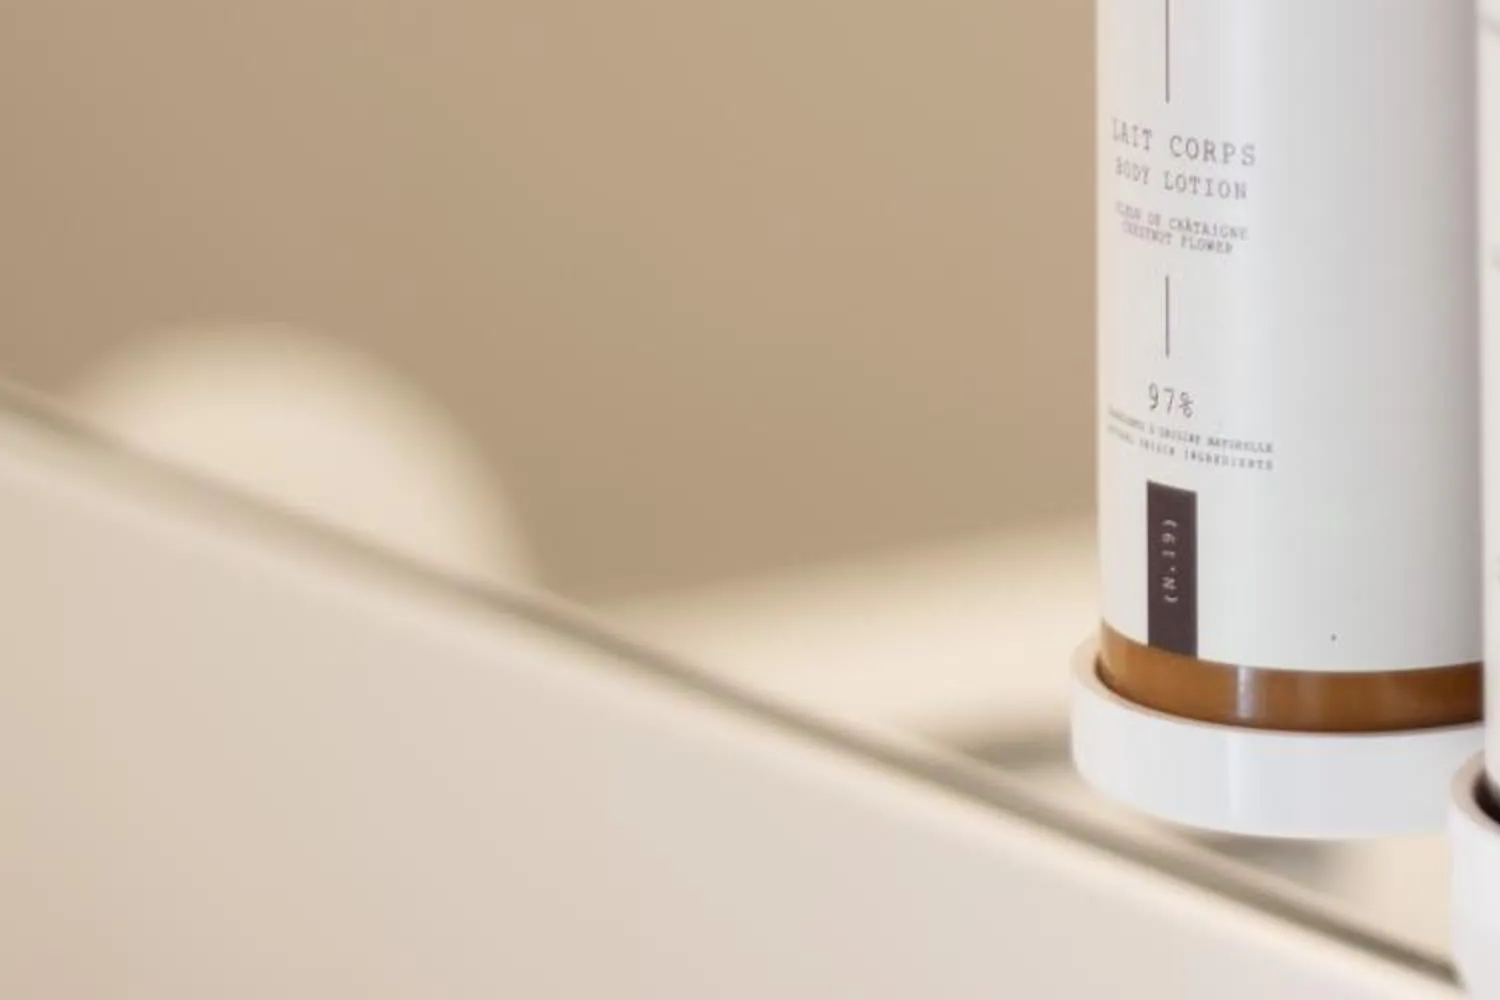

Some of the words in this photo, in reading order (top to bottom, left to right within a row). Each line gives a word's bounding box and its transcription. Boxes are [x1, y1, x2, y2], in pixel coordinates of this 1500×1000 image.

[1112, 117, 1152, 151] LAIT
[1169, 135, 1256, 166] CORPS
[1115, 156, 1150, 185] BODY
[1163, 170, 1247, 199] LOTION
[1148, 382, 1194, 418] 97%
